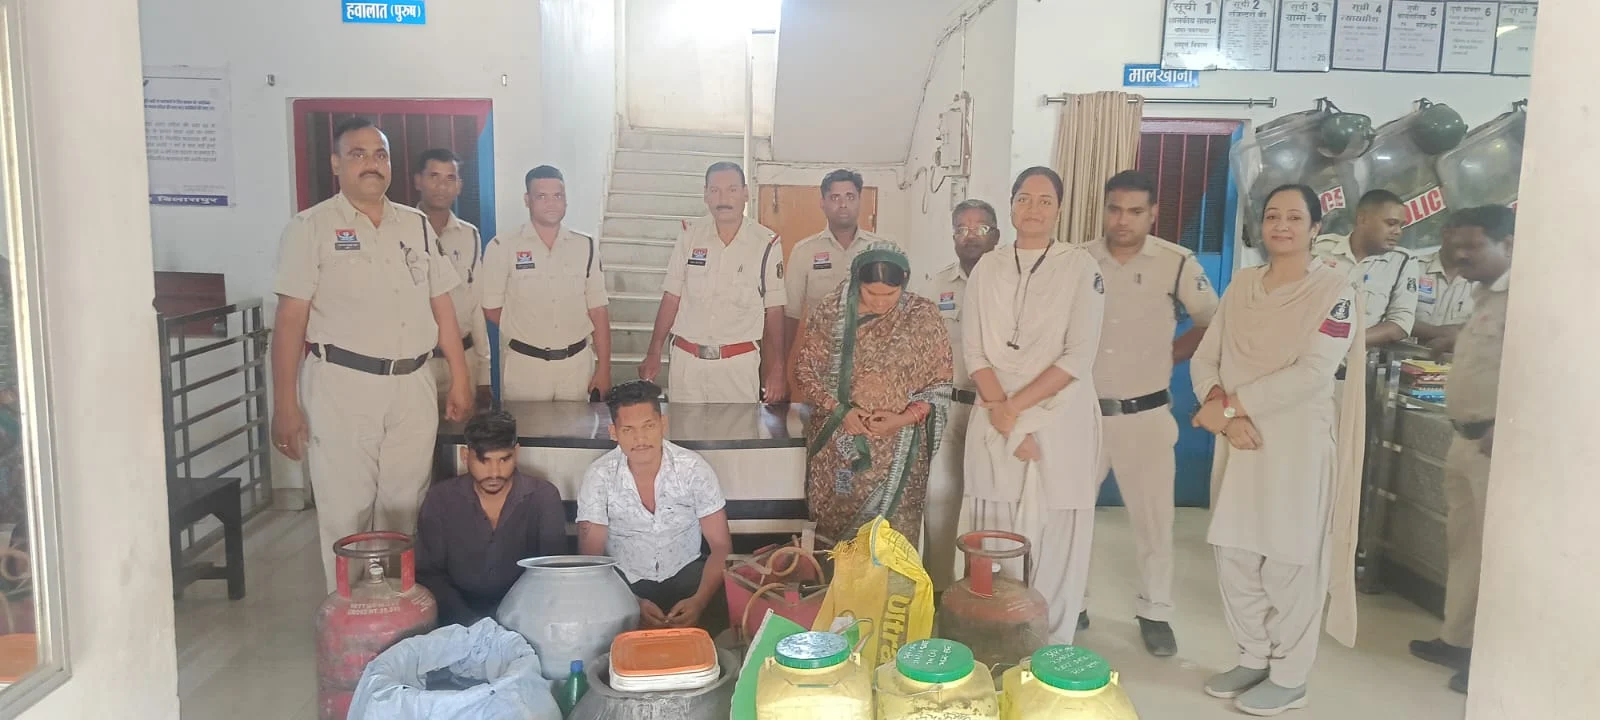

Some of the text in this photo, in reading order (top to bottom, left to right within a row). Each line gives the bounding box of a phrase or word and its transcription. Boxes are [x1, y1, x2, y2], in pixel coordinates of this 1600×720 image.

[1173, 1, 1212, 15] सूची 1
[1252, 0, 1260, 9] 2
[1311, 2, 1319, 12] 3
[1375, 5, 1382, 13] 4
[345, 3, 421, 22] हवालात (पुरुष)
[1430, 7, 1437, 16] 5
[1485, 7, 1491, 16] 6
[1128, 68, 1193, 82] मालखाना
